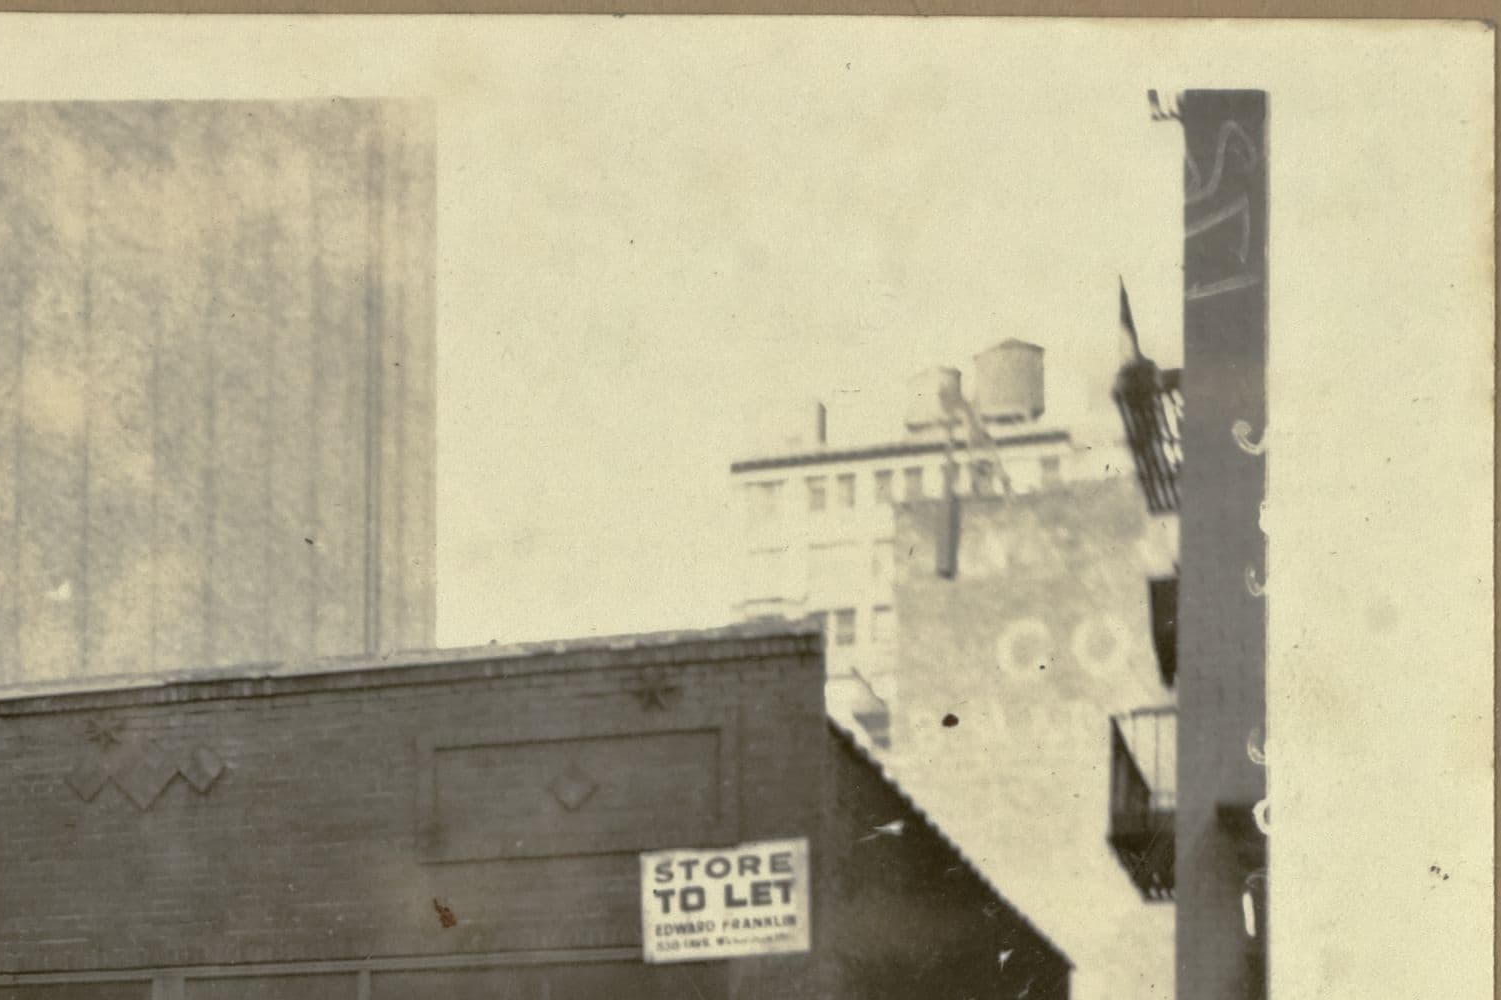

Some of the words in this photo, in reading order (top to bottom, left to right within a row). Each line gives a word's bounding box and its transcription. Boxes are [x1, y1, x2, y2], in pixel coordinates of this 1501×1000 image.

[653, 851, 794, 883] STORE
[653, 885, 706, 915] TO
[723, 878, 796, 908] LET
